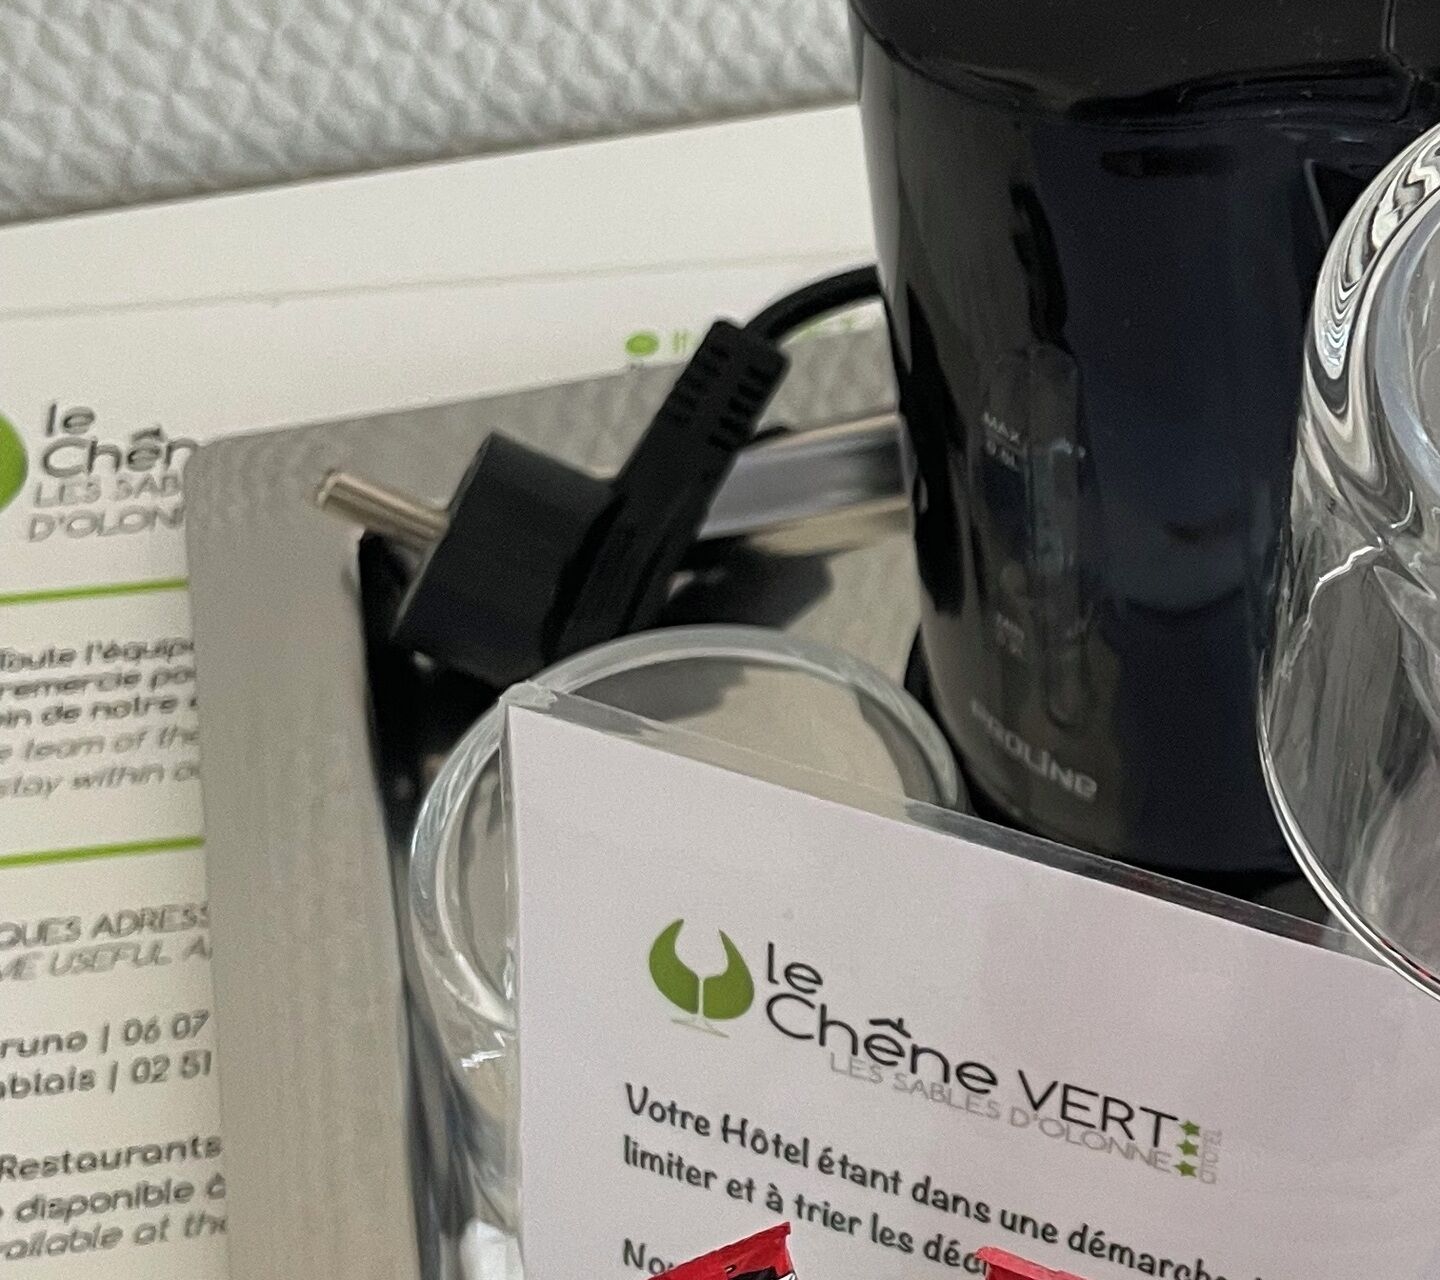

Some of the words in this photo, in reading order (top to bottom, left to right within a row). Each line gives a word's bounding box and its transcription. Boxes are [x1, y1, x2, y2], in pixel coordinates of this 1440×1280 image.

[45, 401, 96, 437] le
[34, 481, 102, 508] LES
[41, 701, 82, 726] de
[90, 695, 178, 721] notre
[111, 729, 148, 754] of
[767, 942, 823, 992] le
[122, 1016, 162, 1047] 06
[130, 1053, 171, 1085] 02
[764, 990, 998, 1096] Chêne
[1017, 1070, 1180, 1149] VERT
[829, 1052, 884, 1086] LES
[893, 1071, 1002, 1121] SABLES
[1009, 1106, 1173, 1175] D'OLONNE
[625, 1081, 711, 1138] Votre
[720, 1110, 811, 1170] Hôtel
[817, 1144, 904, 1197] étant
[911, 1174, 991, 1225] dans
[999, 1207, 1059, 1245] une
[15, 1177, 196, 1224] disponible
[620, 1134, 719, 1192] limiter
[726, 1170, 757, 1204] et
[764, 1181, 785, 1216] à
[795, 1187, 864, 1238] trier
[871, 1211, 914, 1255] les
[132, 1212, 172, 1247] at
[623, 1237, 675, 1276] No
